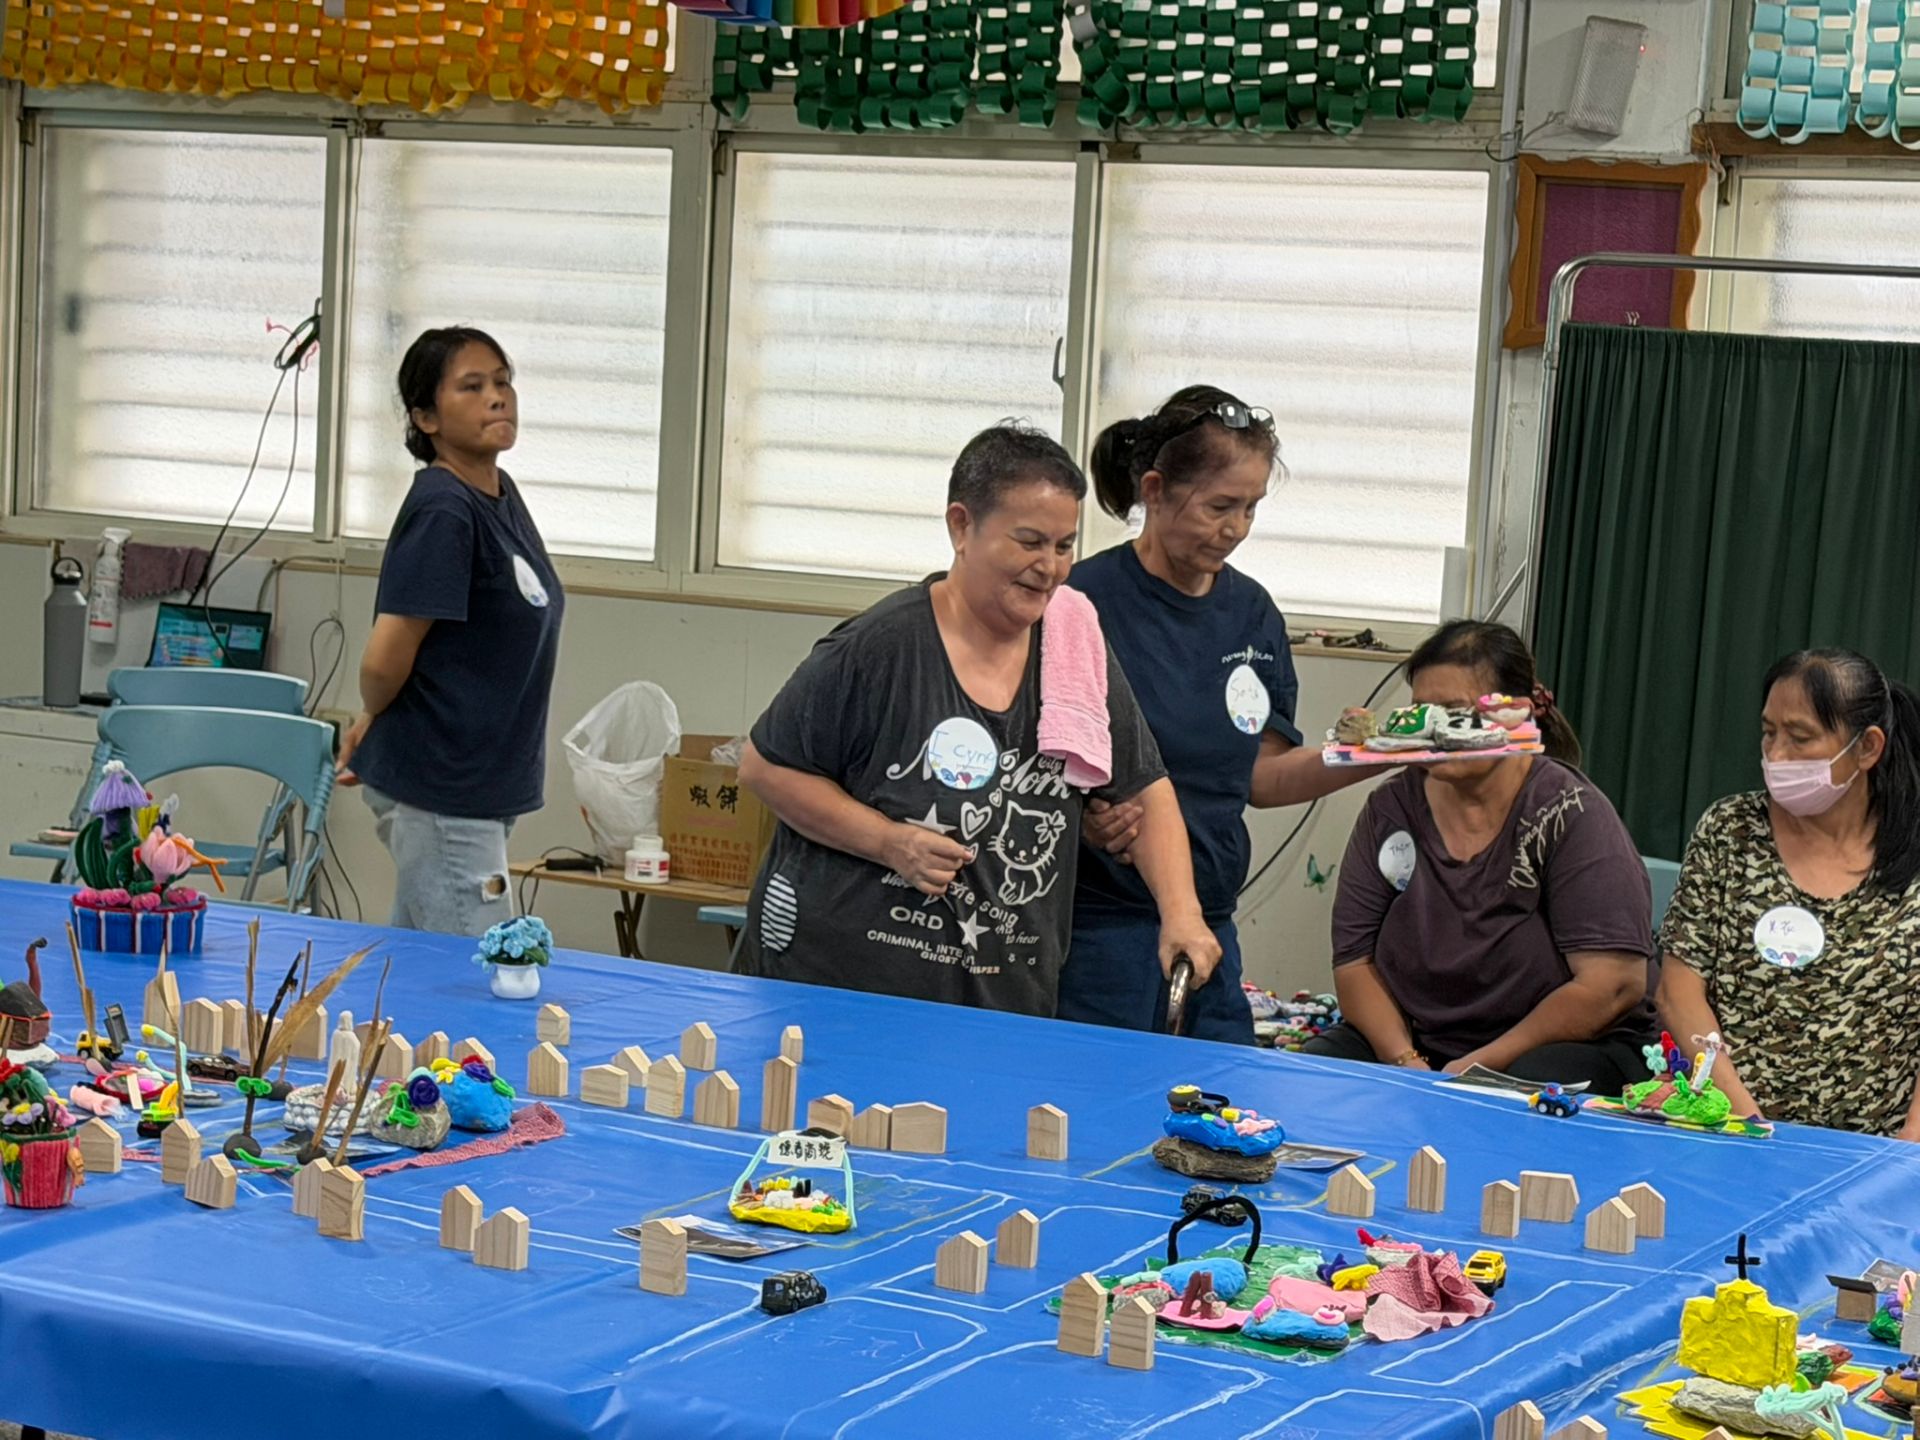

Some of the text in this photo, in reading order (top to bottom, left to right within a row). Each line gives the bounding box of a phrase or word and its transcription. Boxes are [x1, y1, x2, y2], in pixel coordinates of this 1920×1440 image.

[689, 784, 739, 814] 蝦餅
[889, 906, 944, 930] ORD
[866, 930, 933, 952] CRIMINAL
[920, 950, 959, 965] GHOST
